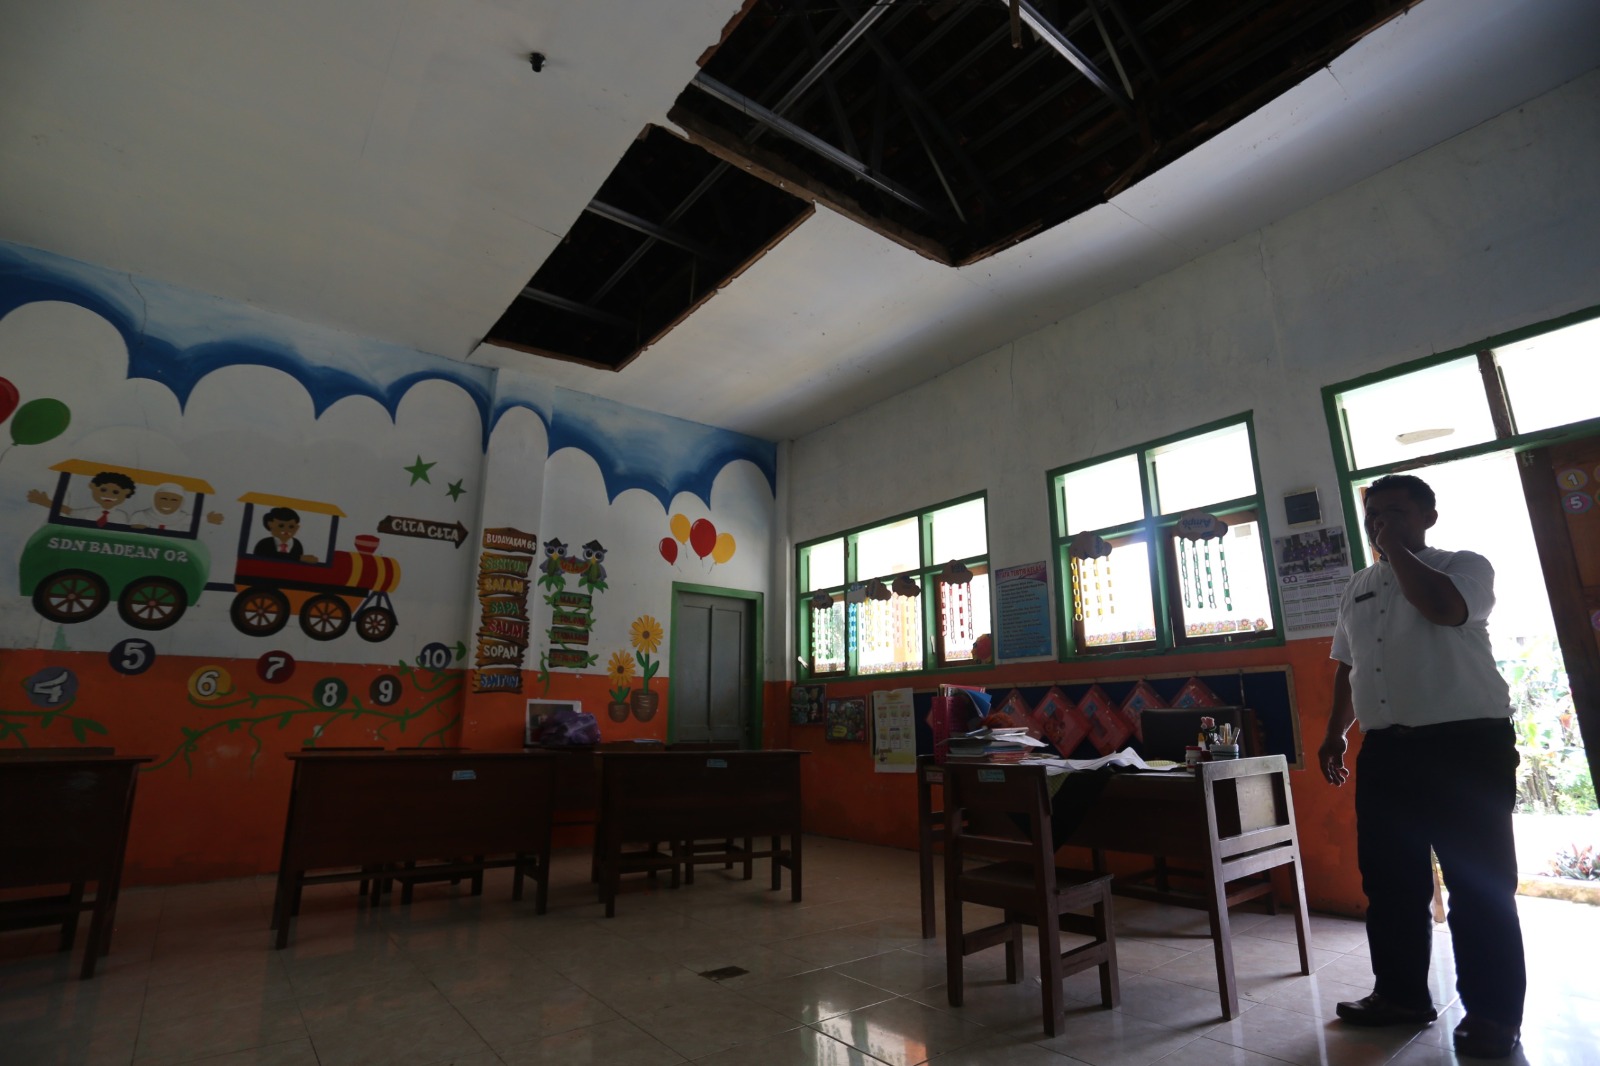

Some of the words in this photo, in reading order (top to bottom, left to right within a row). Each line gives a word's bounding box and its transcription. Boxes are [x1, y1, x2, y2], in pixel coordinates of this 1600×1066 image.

[1568, 473, 1579, 486] 1
[1570, 496, 1583, 509] 5
[47, 537, 85, 552] SDN
[88, 541, 159, 560] BADEAN
[164, 549, 188, 563] 02
[484, 577, 524, 592] SALAM
[489, 601, 519, 615] SAPA
[121, 642, 147, 670] 5
[423, 648, 447, 668] 10
[483, 644, 519, 660] SOPAN
[264, 656, 286, 681] 7
[32, 671, 68, 703] 4
[196, 670, 220, 697] 6
[321, 681, 338, 707] 8
[378, 679, 394, 702] 9
